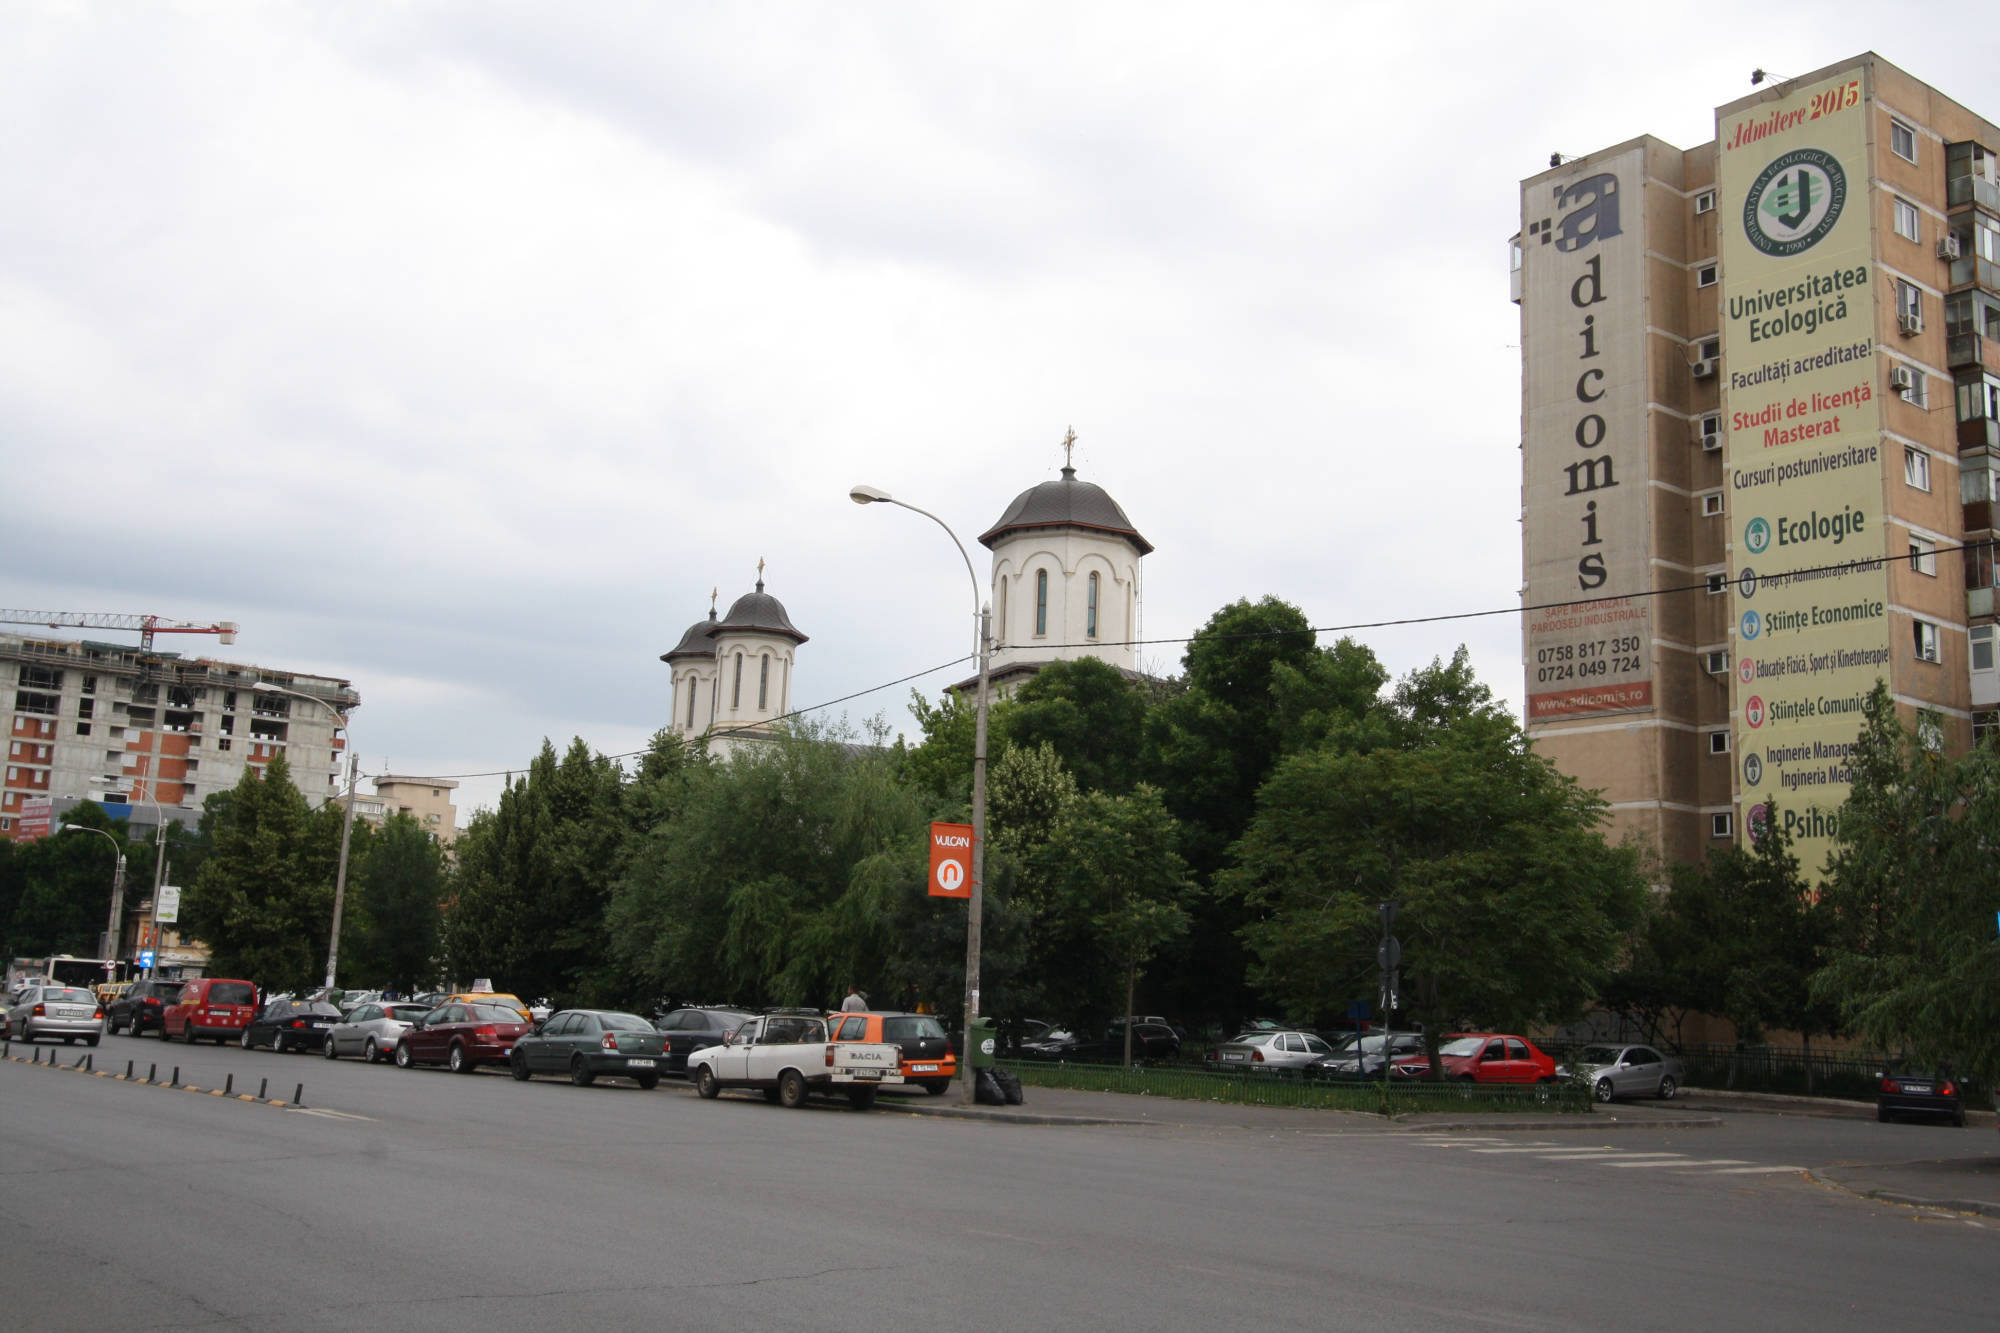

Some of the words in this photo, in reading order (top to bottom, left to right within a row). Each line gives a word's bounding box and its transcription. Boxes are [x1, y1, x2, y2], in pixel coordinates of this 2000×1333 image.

[1727, 107, 1806, 150] Admitere
[1810, 81, 1859, 120] 2015
[1730, 266, 1867, 319] Universitatea
[1750, 294, 1847, 342] Ecologică
[1732, 361, 1790, 390] Facultăți
[1794, 338, 1872, 374] acreditate!
[1733, 402, 1782, 431] Studii
[1786, 398, 1807, 418] de
[1812, 381, 1872, 412] licență
[1764, 415, 1840, 448] Masterat
[1734, 462, 1775, 490] Cursuri
[1778, 445, 1877, 486] postuniversitare
[1778, 505, 1864, 546] Ecologie
[1761, 574, 1783, 590] Drept
[1584, 607, 1647, 626] INDUSTRIALE
[1812, 598, 1883, 626] Economice
[1538, 645, 1573, 663] 0758
[1579, 640, 1606, 658] 817
[1612, 636, 1640, 654] 350
[1810, 653, 1829, 676] Sport
[1838, 644, 1888, 669] Kinetoterapie
[1538, 664, 1573, 682] 0724
[1579, 660, 1606, 677] 049
[1612, 655, 1640, 673] 724
[1537, 690, 1643, 711] www.adicomis.ro
[1766, 743, 1811, 767] Inginerie
[1781, 767, 1826, 791] Ingineria
[935, 834, 970, 848] VULCAN
[850, 1053, 882, 1061] DACIA
